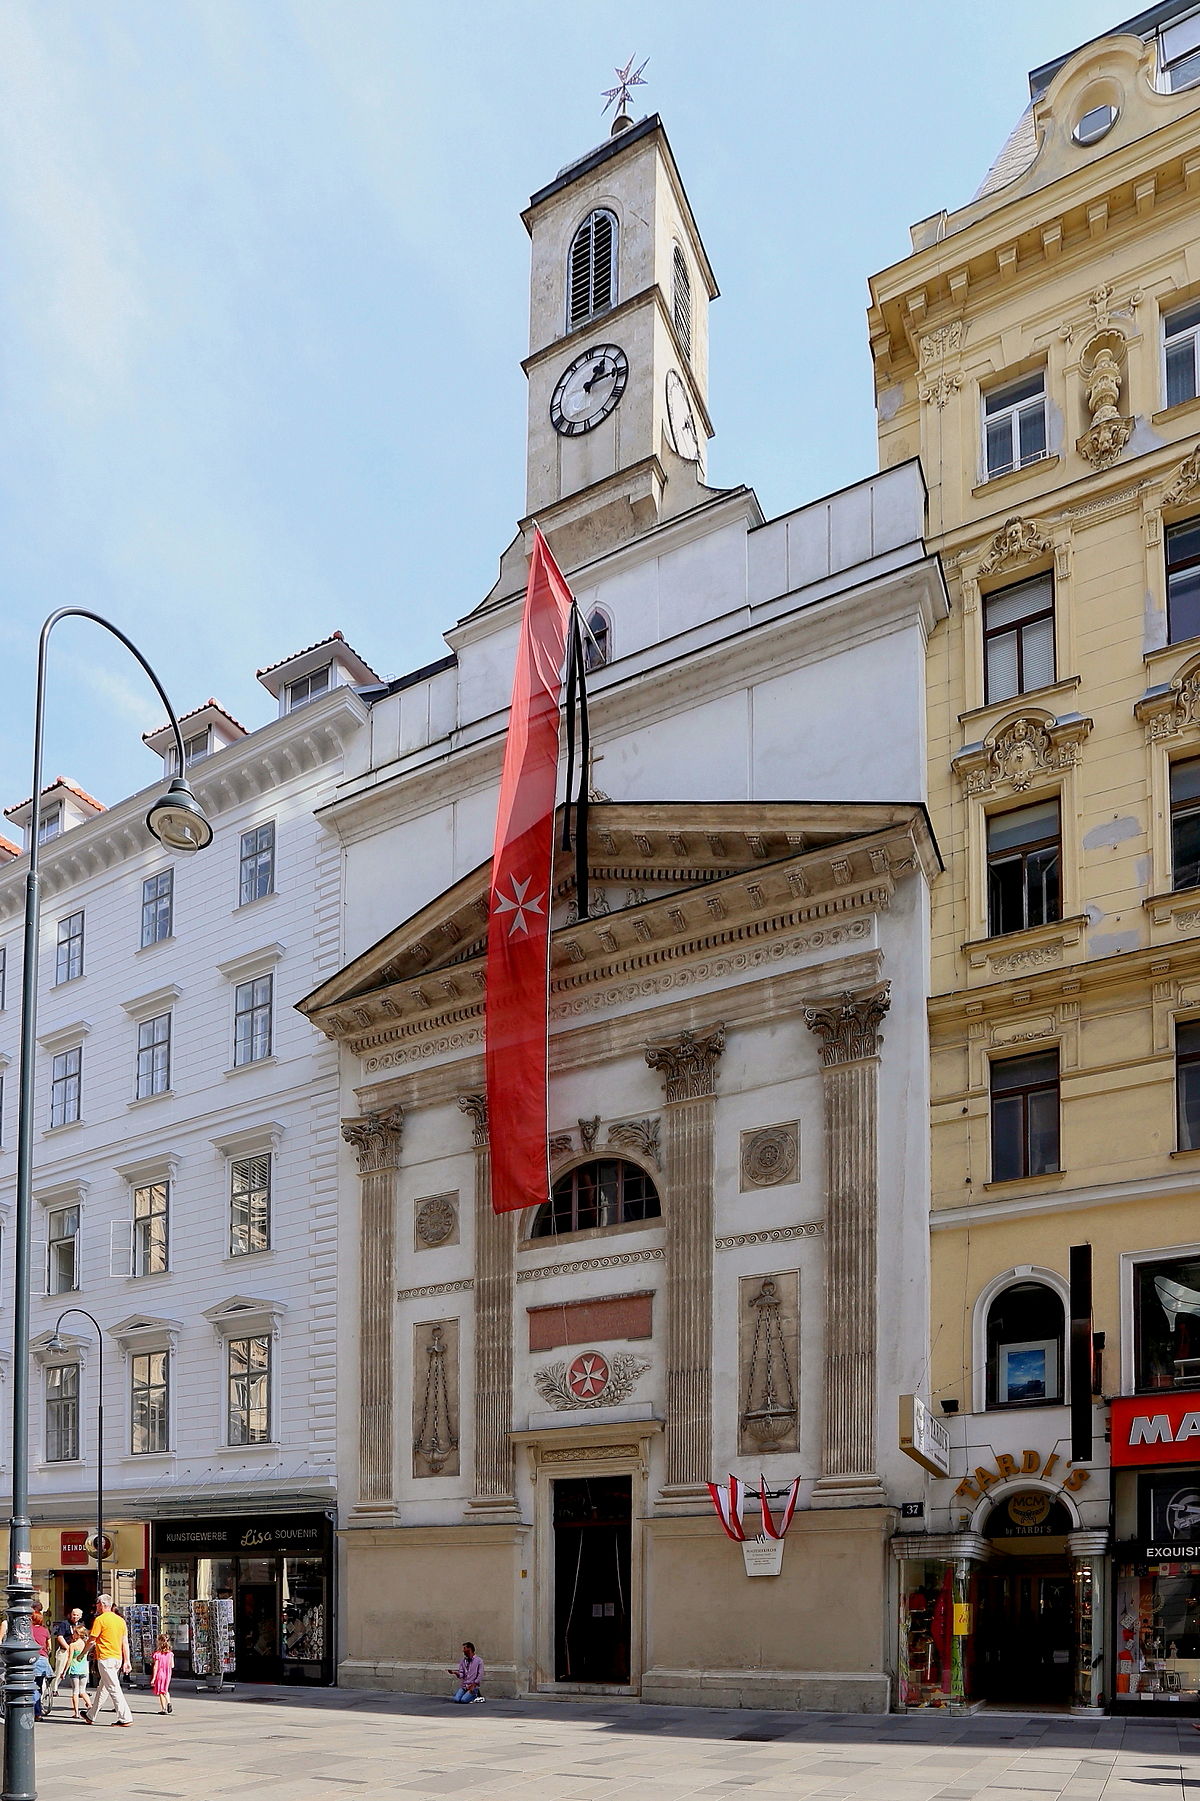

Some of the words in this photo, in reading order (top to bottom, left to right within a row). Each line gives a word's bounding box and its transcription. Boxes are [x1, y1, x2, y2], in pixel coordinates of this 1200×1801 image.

[955, 1450, 1091, 1500] TARDI'S
[1013, 1495, 1045, 1507] MCM
[906, 1504, 919, 1515] 37
[1016, 1525, 1052, 1535] TARDI'S
[166, 1531, 228, 1542] KUNSTGEWERBE
[240, 1529, 272, 1547] Lisa
[274, 1528, 318, 1539] SOUVENIR
[62, 1544, 86, 1552] HEINDL
